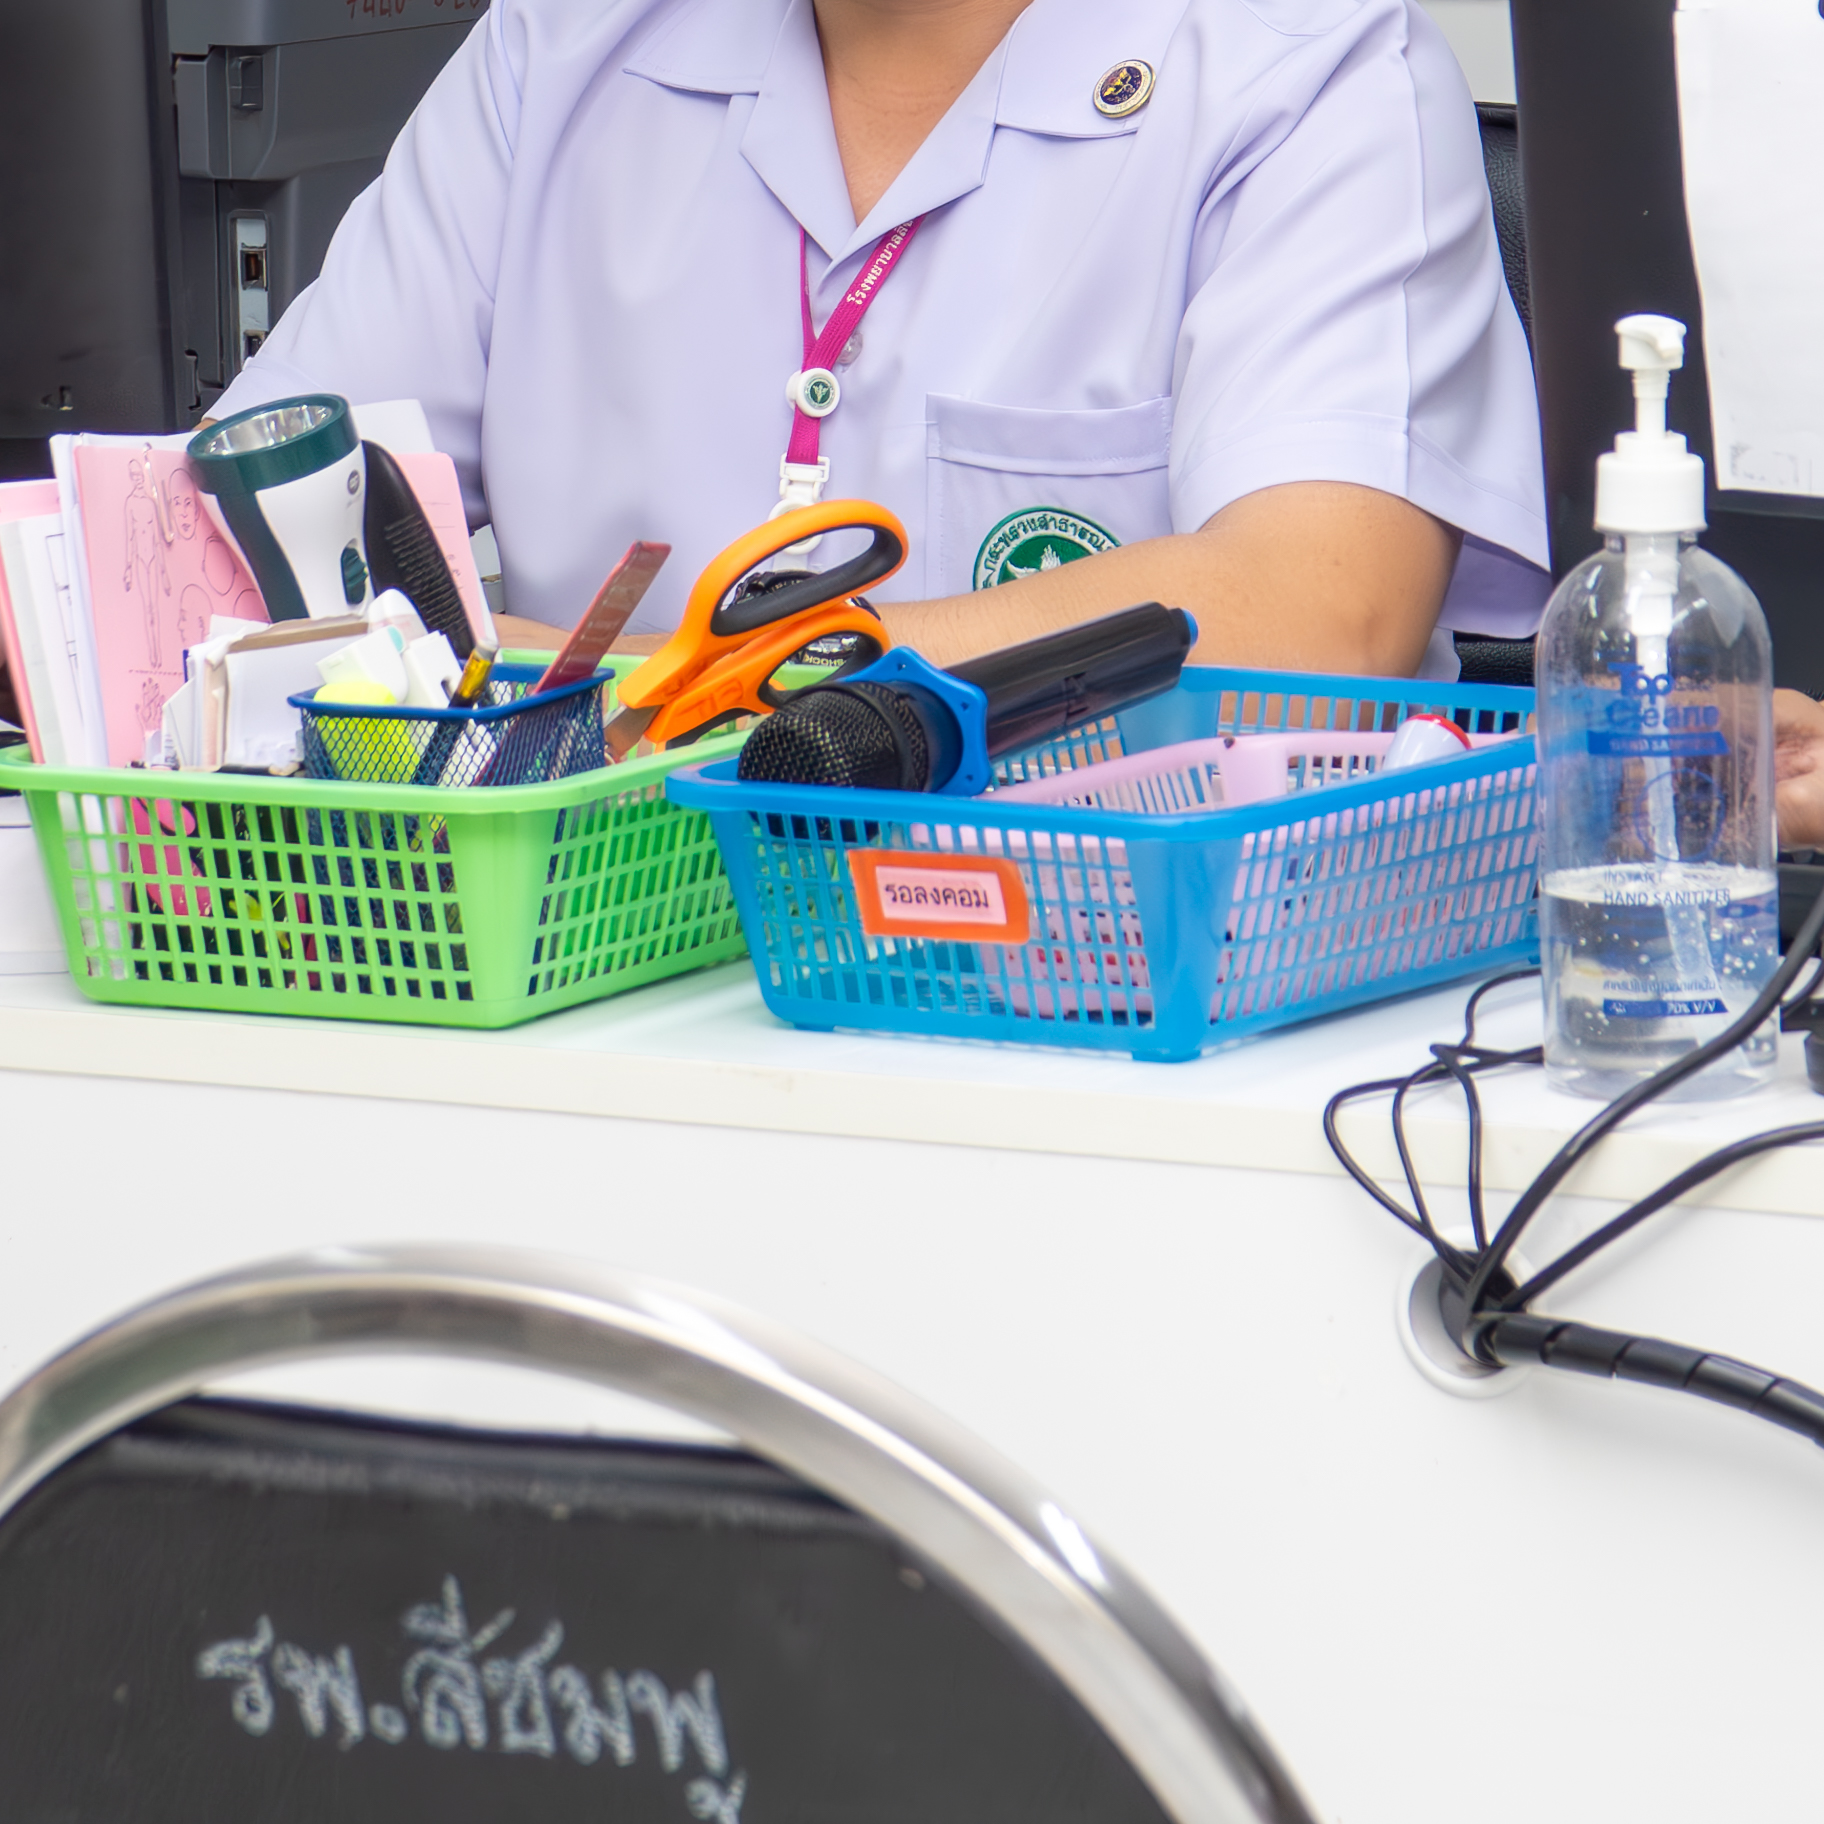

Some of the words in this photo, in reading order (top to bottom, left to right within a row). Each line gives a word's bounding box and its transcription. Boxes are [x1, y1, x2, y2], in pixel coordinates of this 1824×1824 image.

[884, 882, 990, 909] รอลงคอม
[1603, 889, 1648, 905] HAND
[1653, 888, 1731, 905] SANITIZER
[196, 1573, 748, 1824] รพ.สีชมพู
